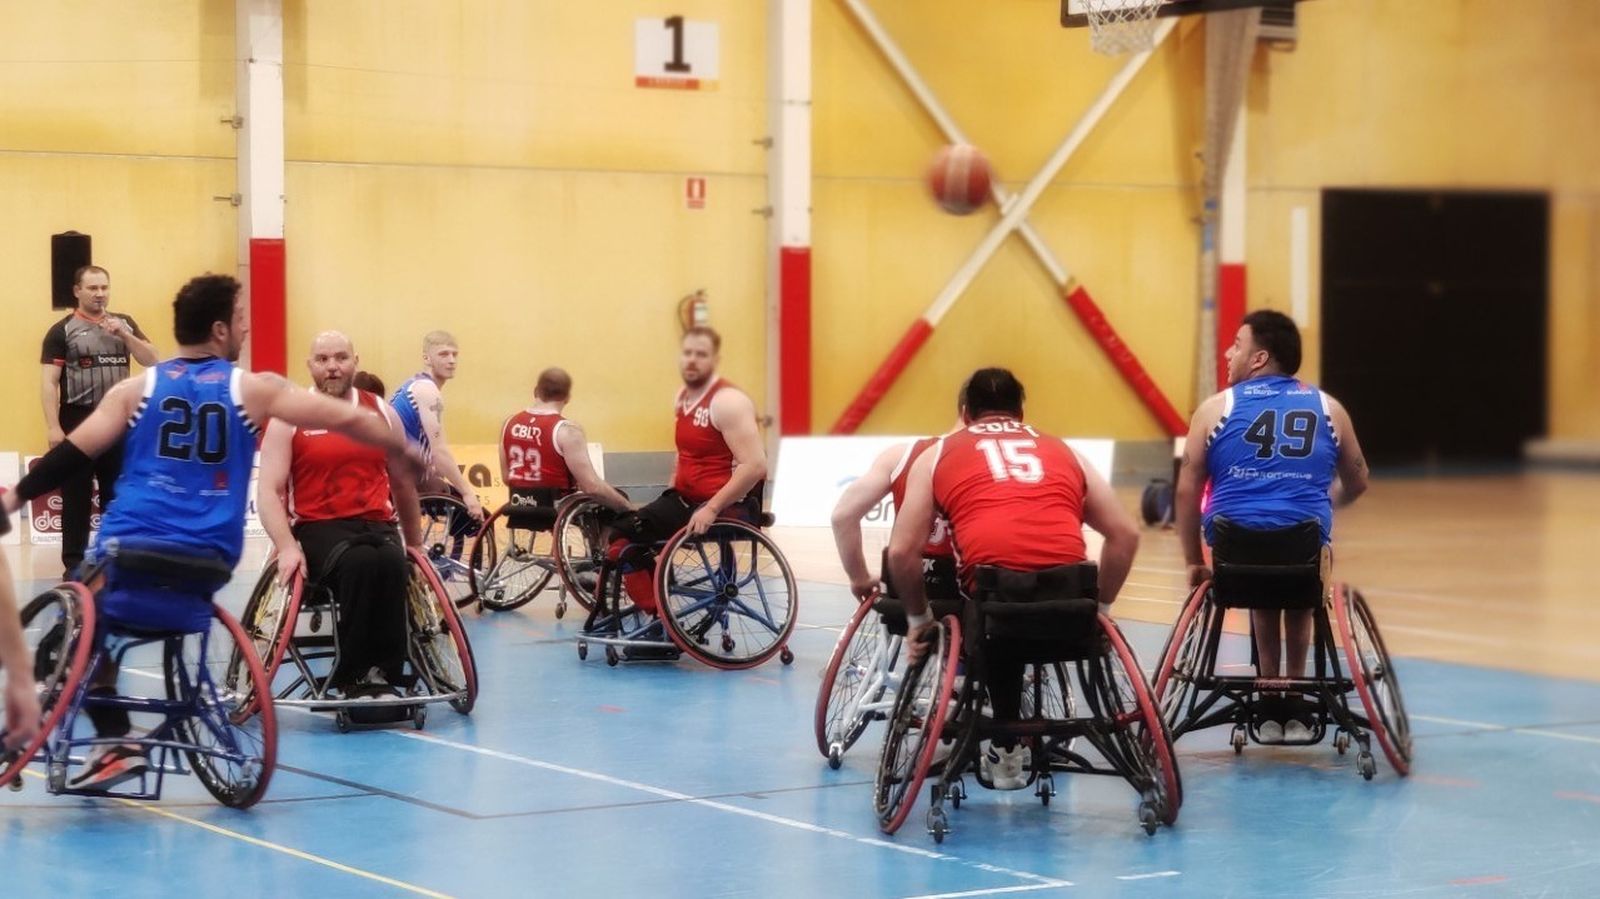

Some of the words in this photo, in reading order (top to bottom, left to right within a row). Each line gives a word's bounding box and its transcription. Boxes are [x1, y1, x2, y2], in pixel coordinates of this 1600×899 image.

[664, 15, 691, 73] 1
[156, 396, 229, 465] 20
[1242, 409, 1319, 460] 49
[975, 439, 1046, 484] 15
